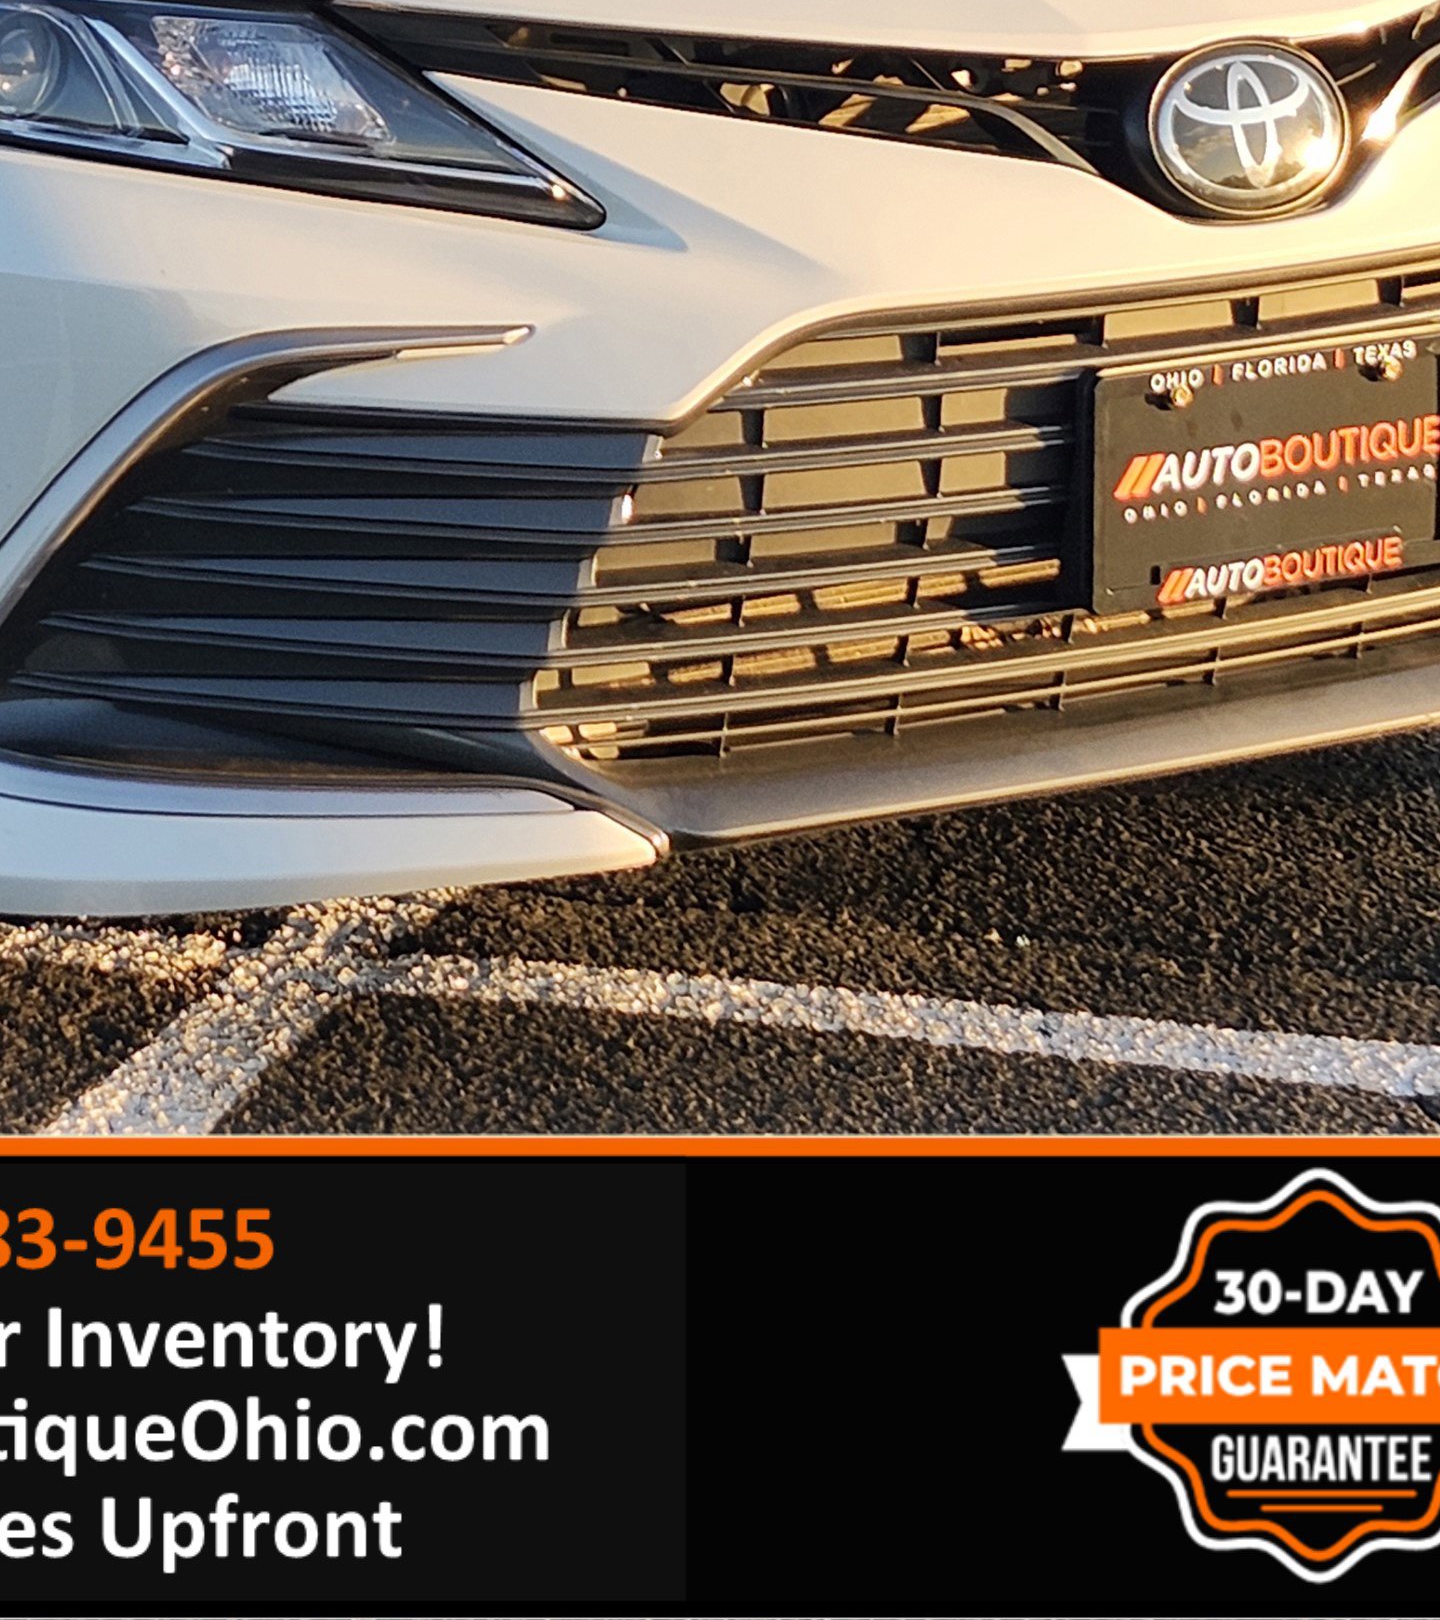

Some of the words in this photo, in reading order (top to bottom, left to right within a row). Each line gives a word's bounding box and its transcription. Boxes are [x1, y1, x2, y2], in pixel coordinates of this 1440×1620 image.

[1150, 367, 1205, 393] OHIO
[1231, 352, 1328, 381] FLORIDA
[1353, 339, 1417, 366] TEXAS
[1183, 535, 1403, 600] AUTOBOUTIQUE
